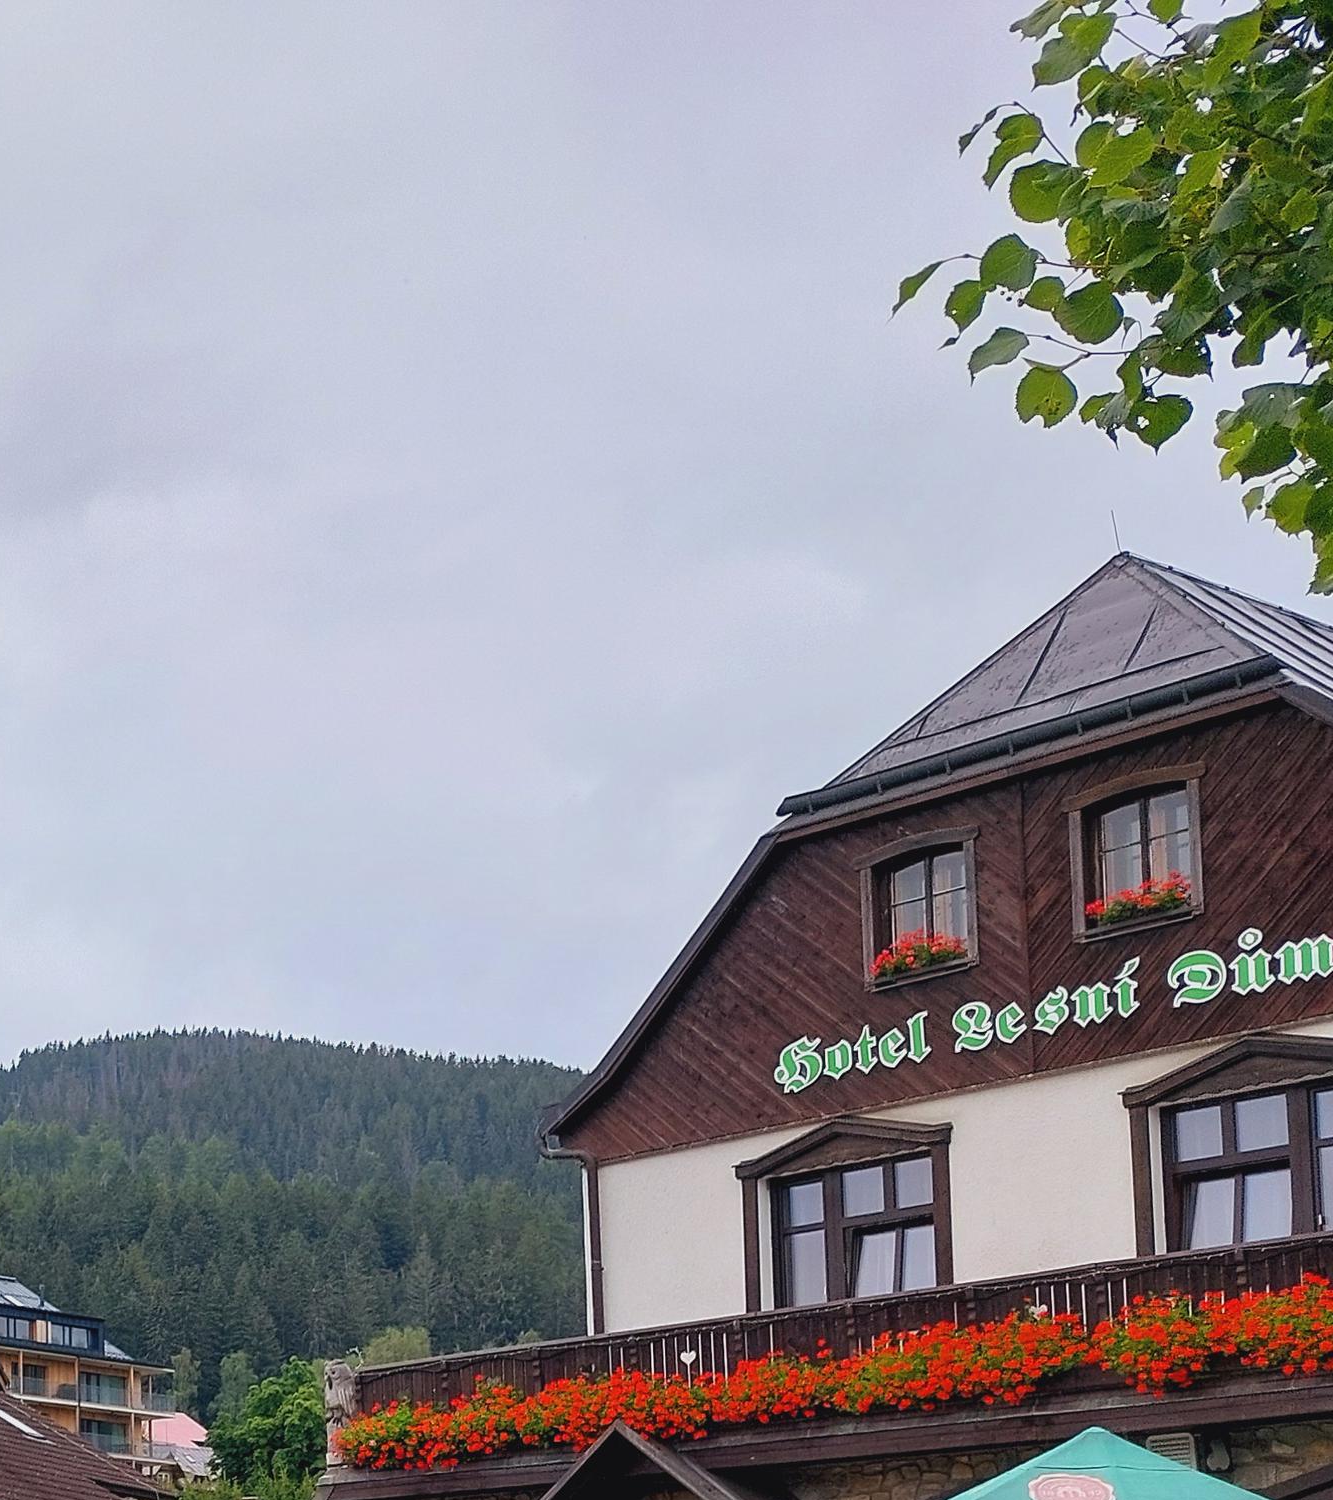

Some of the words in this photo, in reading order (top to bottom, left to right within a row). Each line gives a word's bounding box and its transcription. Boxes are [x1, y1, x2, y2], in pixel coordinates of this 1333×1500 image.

[773, 1010, 932, 1094] Hotel
[951, 956, 1141, 1054] Lesní
[1167, 927, 1333, 1008] Dům
